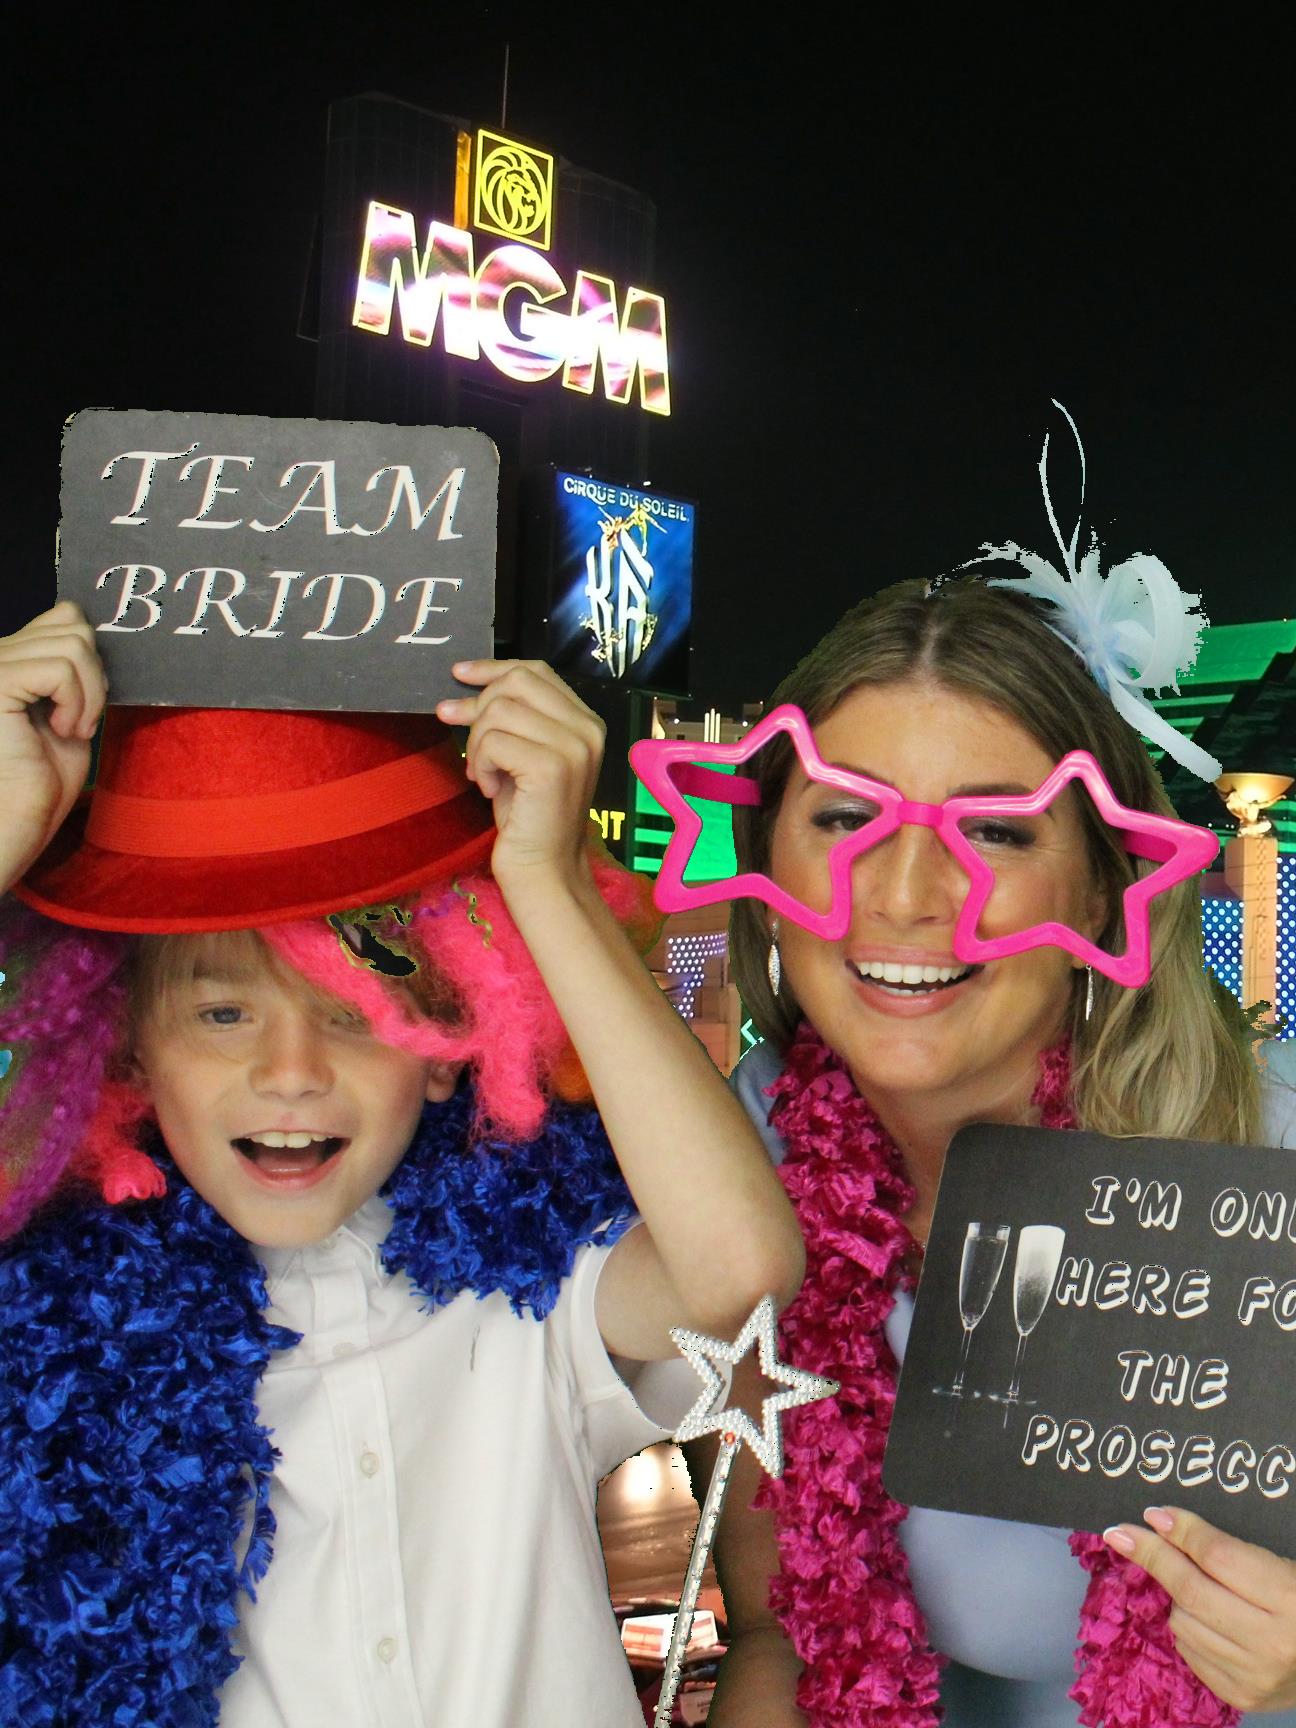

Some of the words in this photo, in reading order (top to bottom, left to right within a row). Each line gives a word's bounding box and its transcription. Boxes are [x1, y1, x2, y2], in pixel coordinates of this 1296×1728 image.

[352, 201, 671, 416] MGM
[101, 442, 467, 541] TEAM
[96, 564, 463, 645] BRIDE
[1085, 1175, 1182, 1231] I'M
[1055, 1256, 1211, 1319] HERE
[1117, 1350, 1229, 1410] THE
